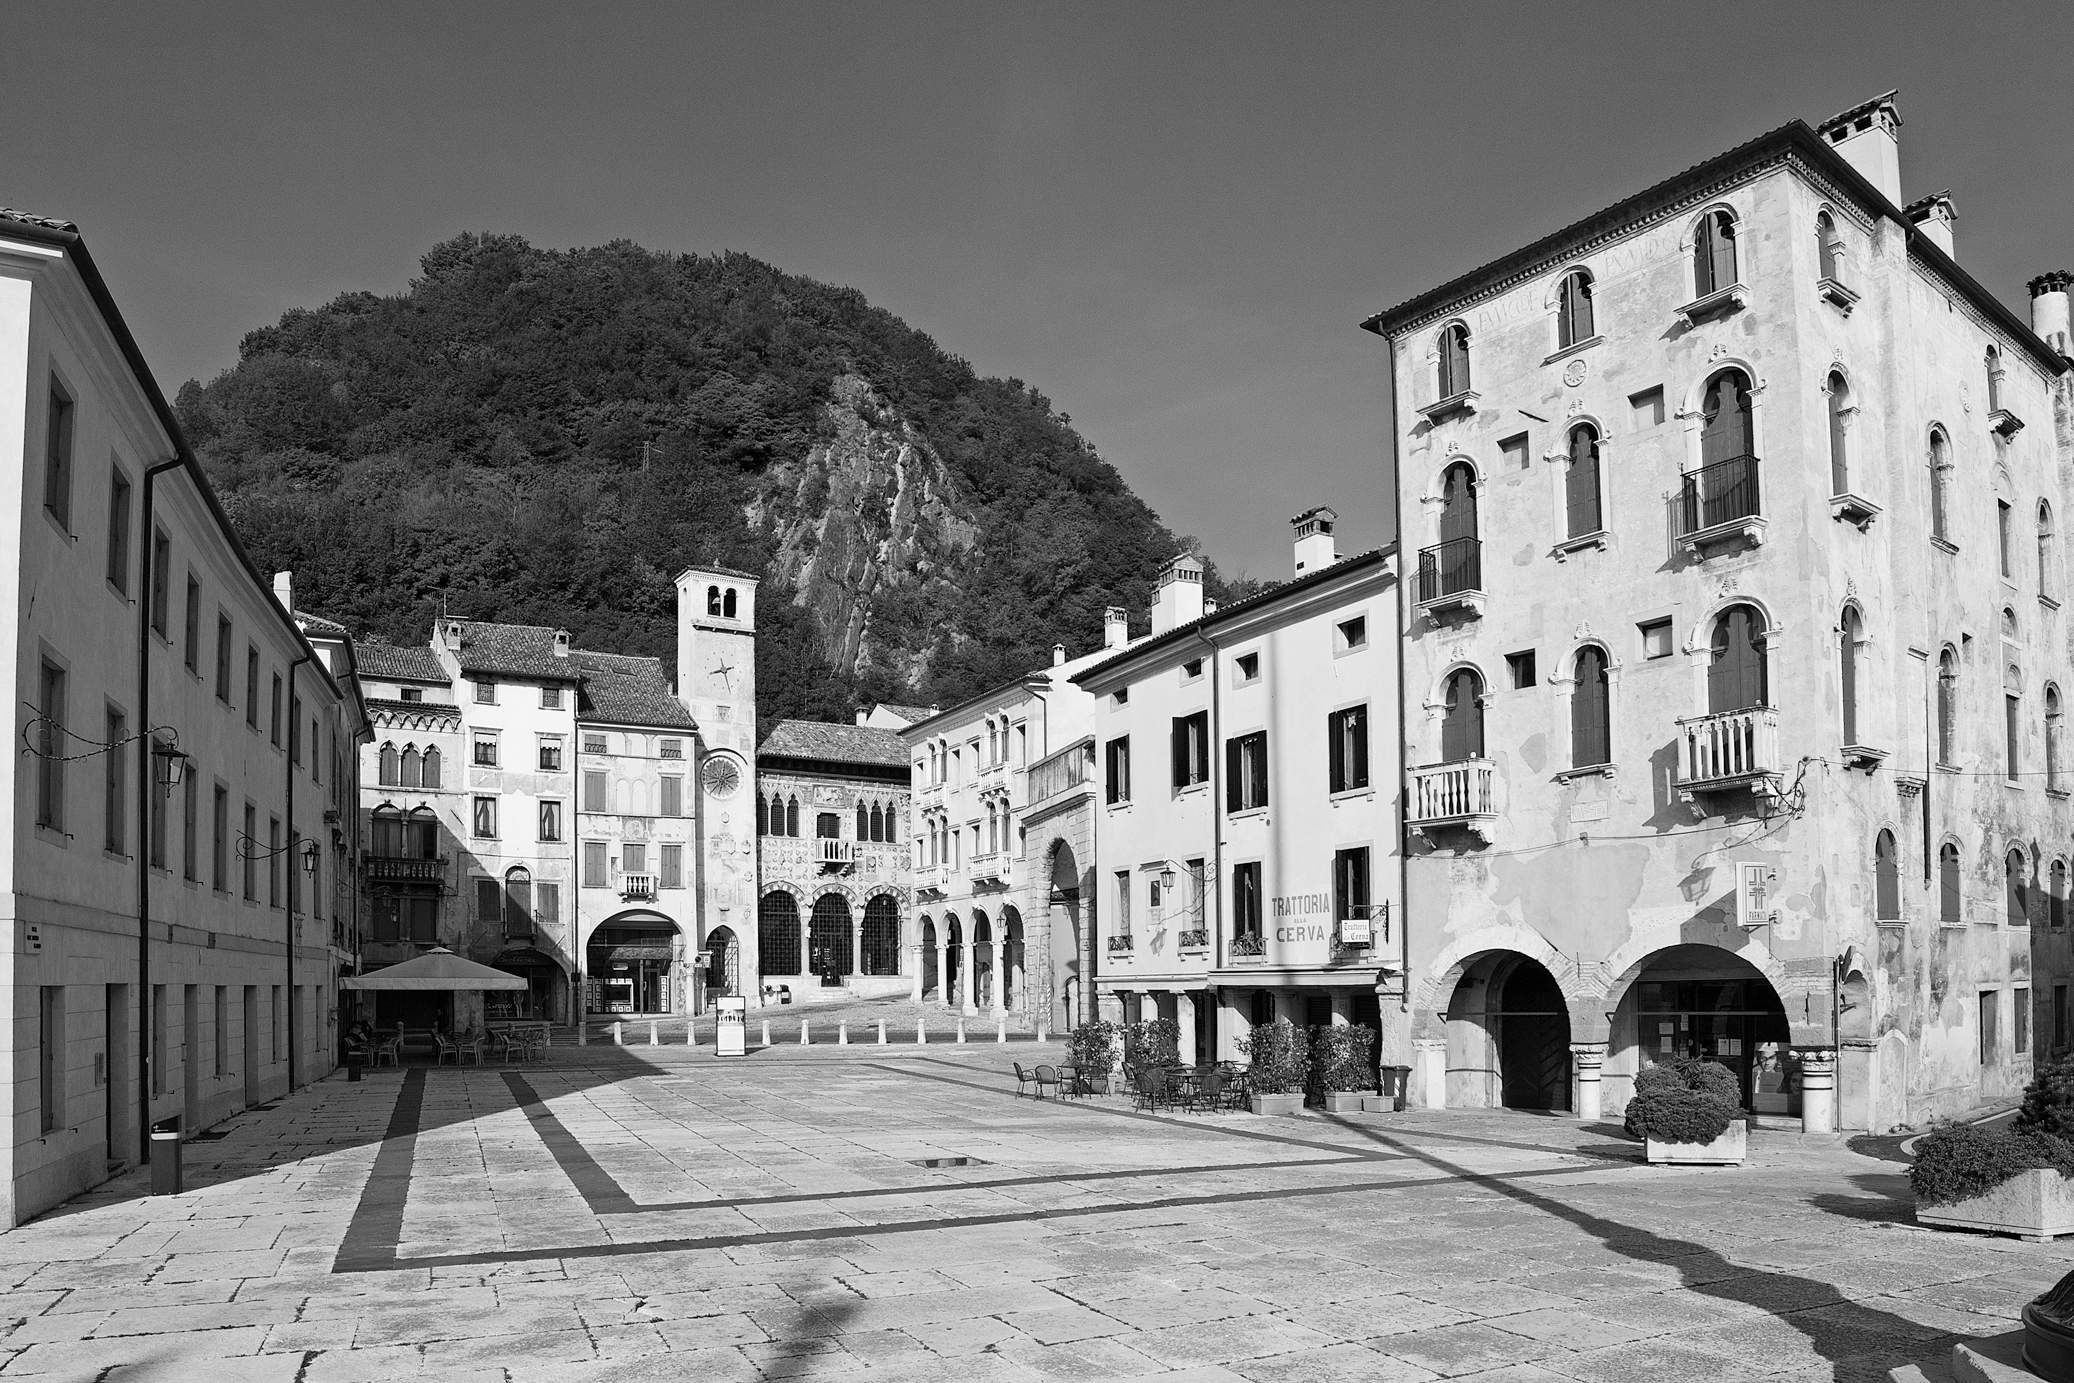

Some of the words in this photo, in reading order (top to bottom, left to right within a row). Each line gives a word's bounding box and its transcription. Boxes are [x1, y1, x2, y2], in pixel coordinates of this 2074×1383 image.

[1272, 893, 1330, 916] TRATTORIA
[1344, 922, 1367, 931] Trattoria
[1276, 925, 1325, 942] CERVA
[1350, 932, 1369, 940] Cerva
